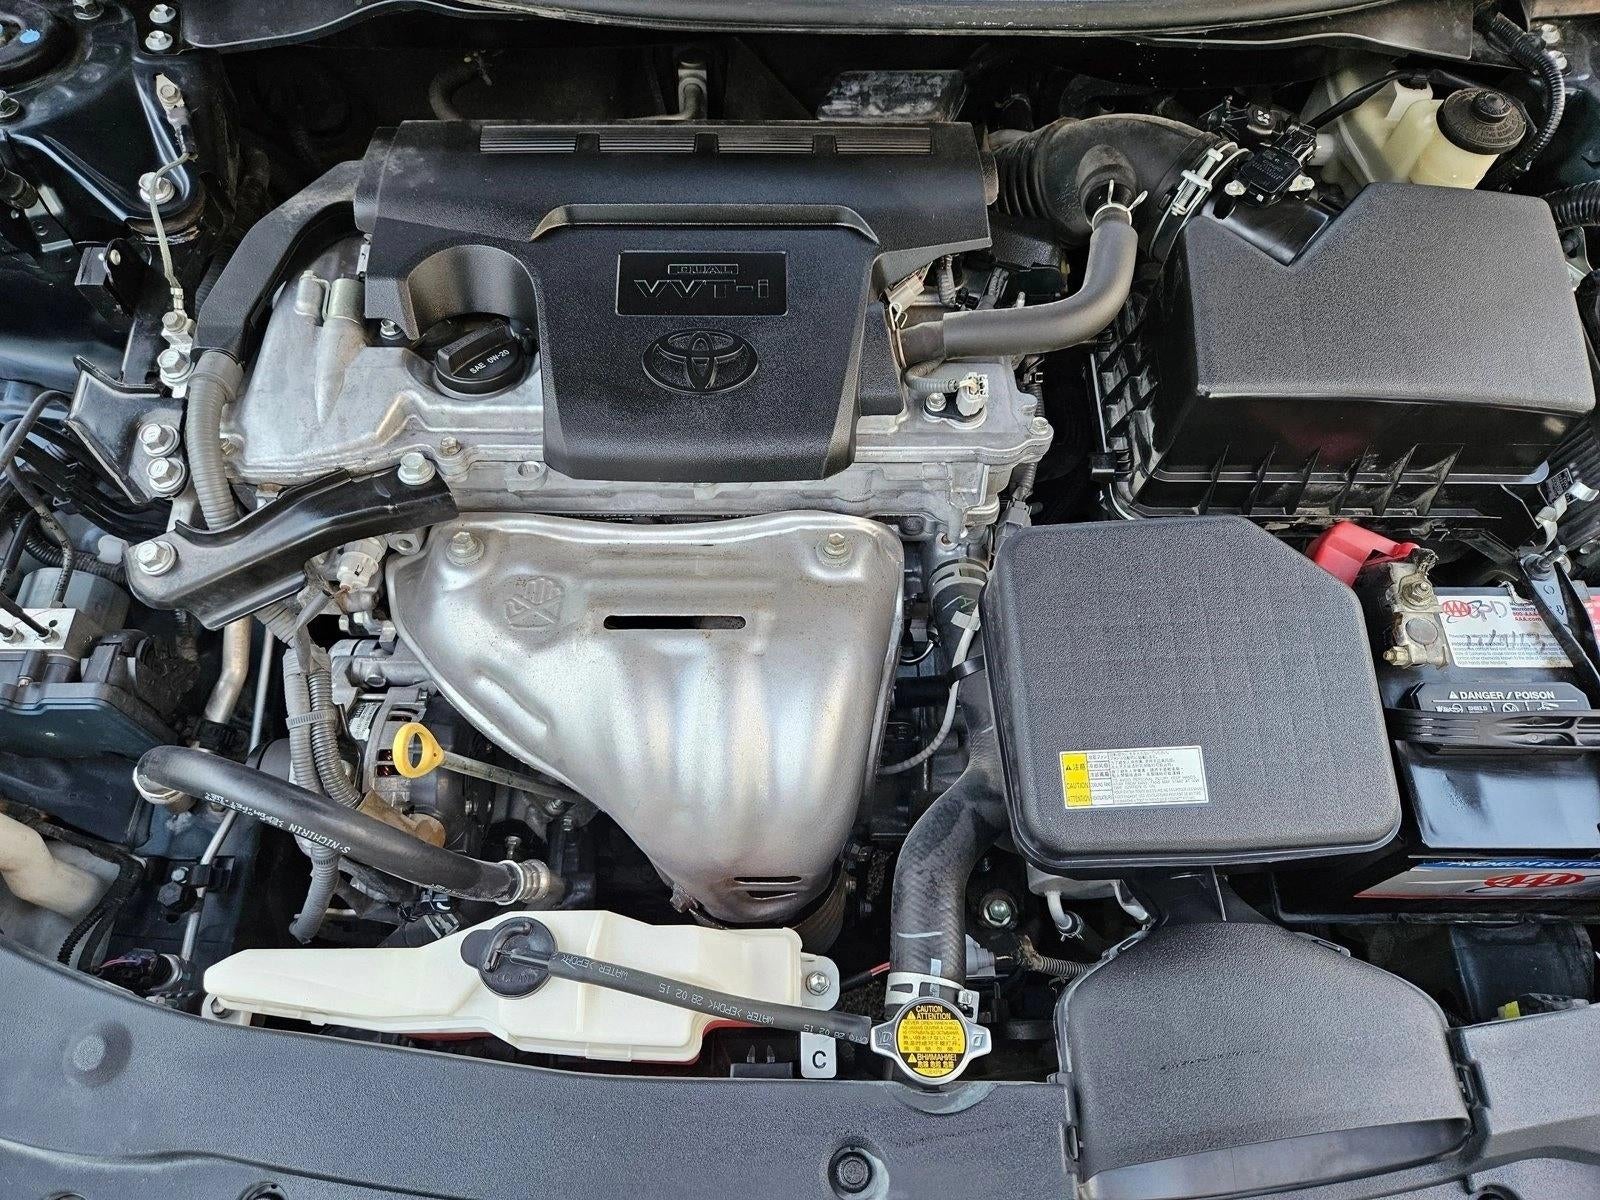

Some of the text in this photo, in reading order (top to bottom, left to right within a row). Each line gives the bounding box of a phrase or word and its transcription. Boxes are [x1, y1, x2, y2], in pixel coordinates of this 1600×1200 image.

[677, 266, 733, 274] DUAL
[633, 279, 769, 298] VVT-i
[469, 349, 510, 374] SAE 0W-20
[1443, 601, 1469, 616] AAA
[1459, 691, 1504, 700] DANGER
[1515, 691, 1555, 700] POISON
[599, 965, 629, 981] WATER
[659, 982, 671, 994] 15
[676, 988, 688, 1000] 02
[691, 994, 703, 1005] 28
[746, 1010, 775, 1025] WATER
[812, 1050, 826, 1069] C
